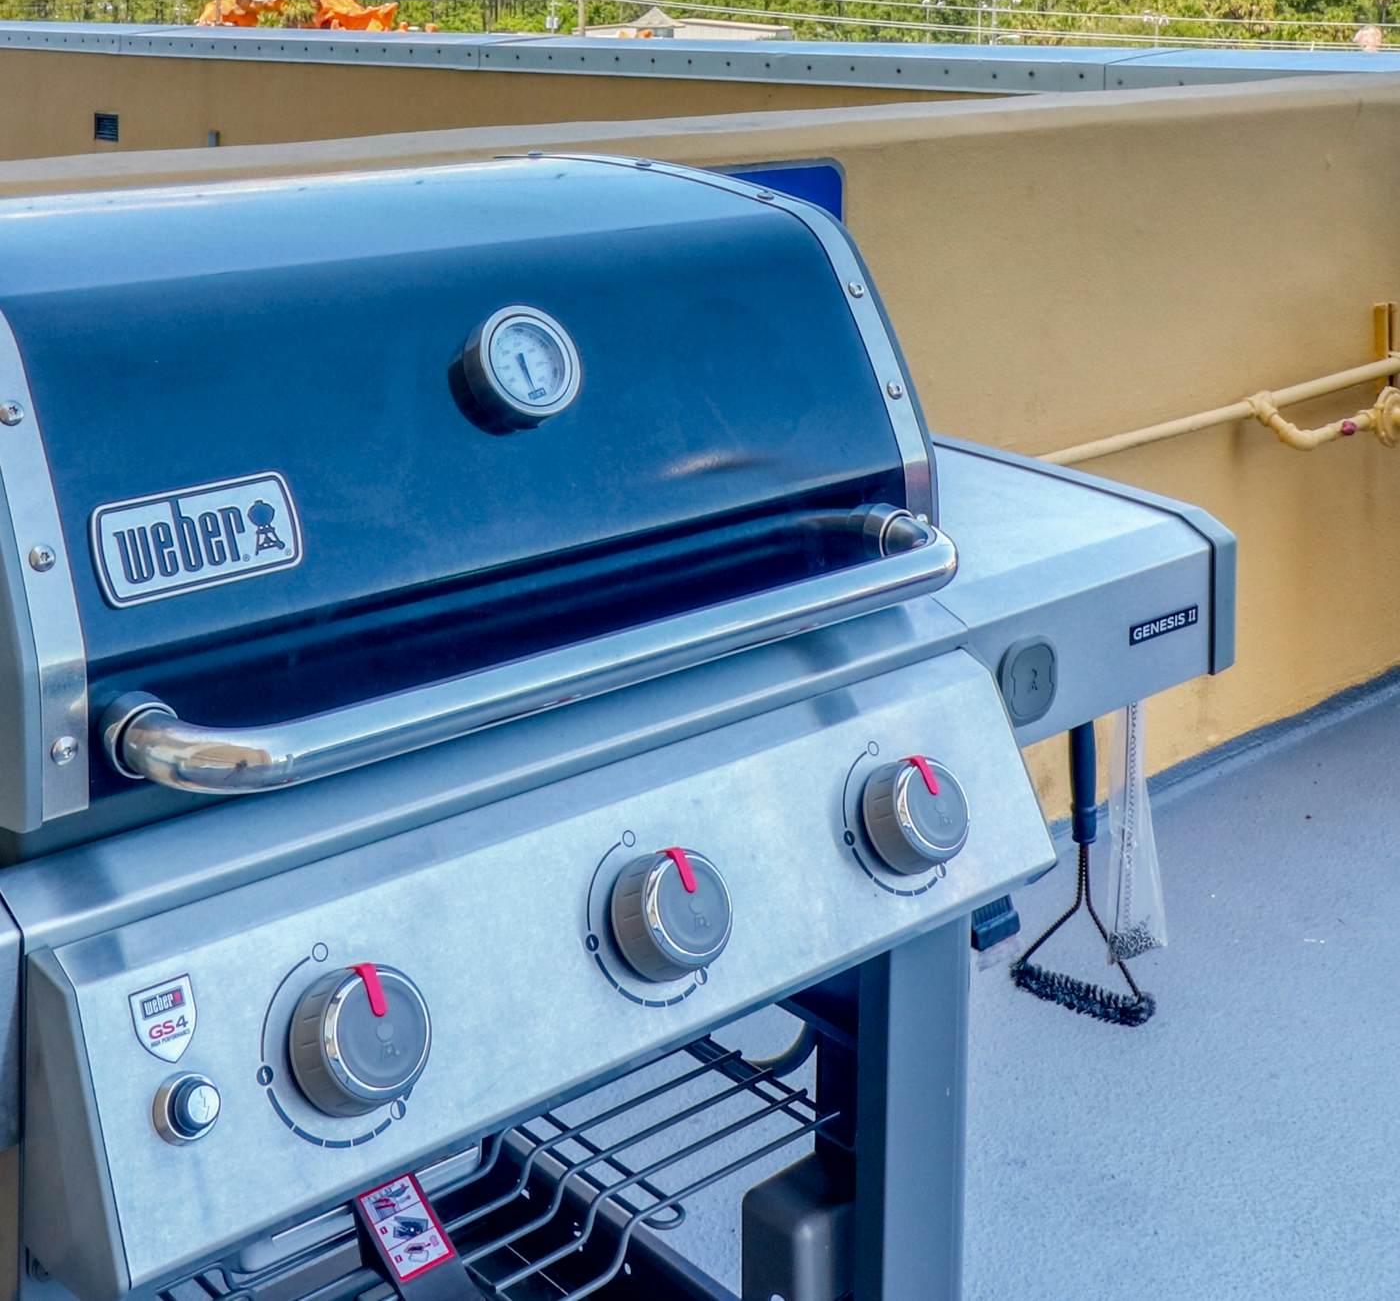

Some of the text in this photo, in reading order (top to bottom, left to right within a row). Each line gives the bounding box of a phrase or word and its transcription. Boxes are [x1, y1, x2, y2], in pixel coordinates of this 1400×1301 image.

[1133, 608, 1197, 641] GENESIS II
[143, 993, 174, 1016] weber
[148, 1014, 189, 1040] GS4
